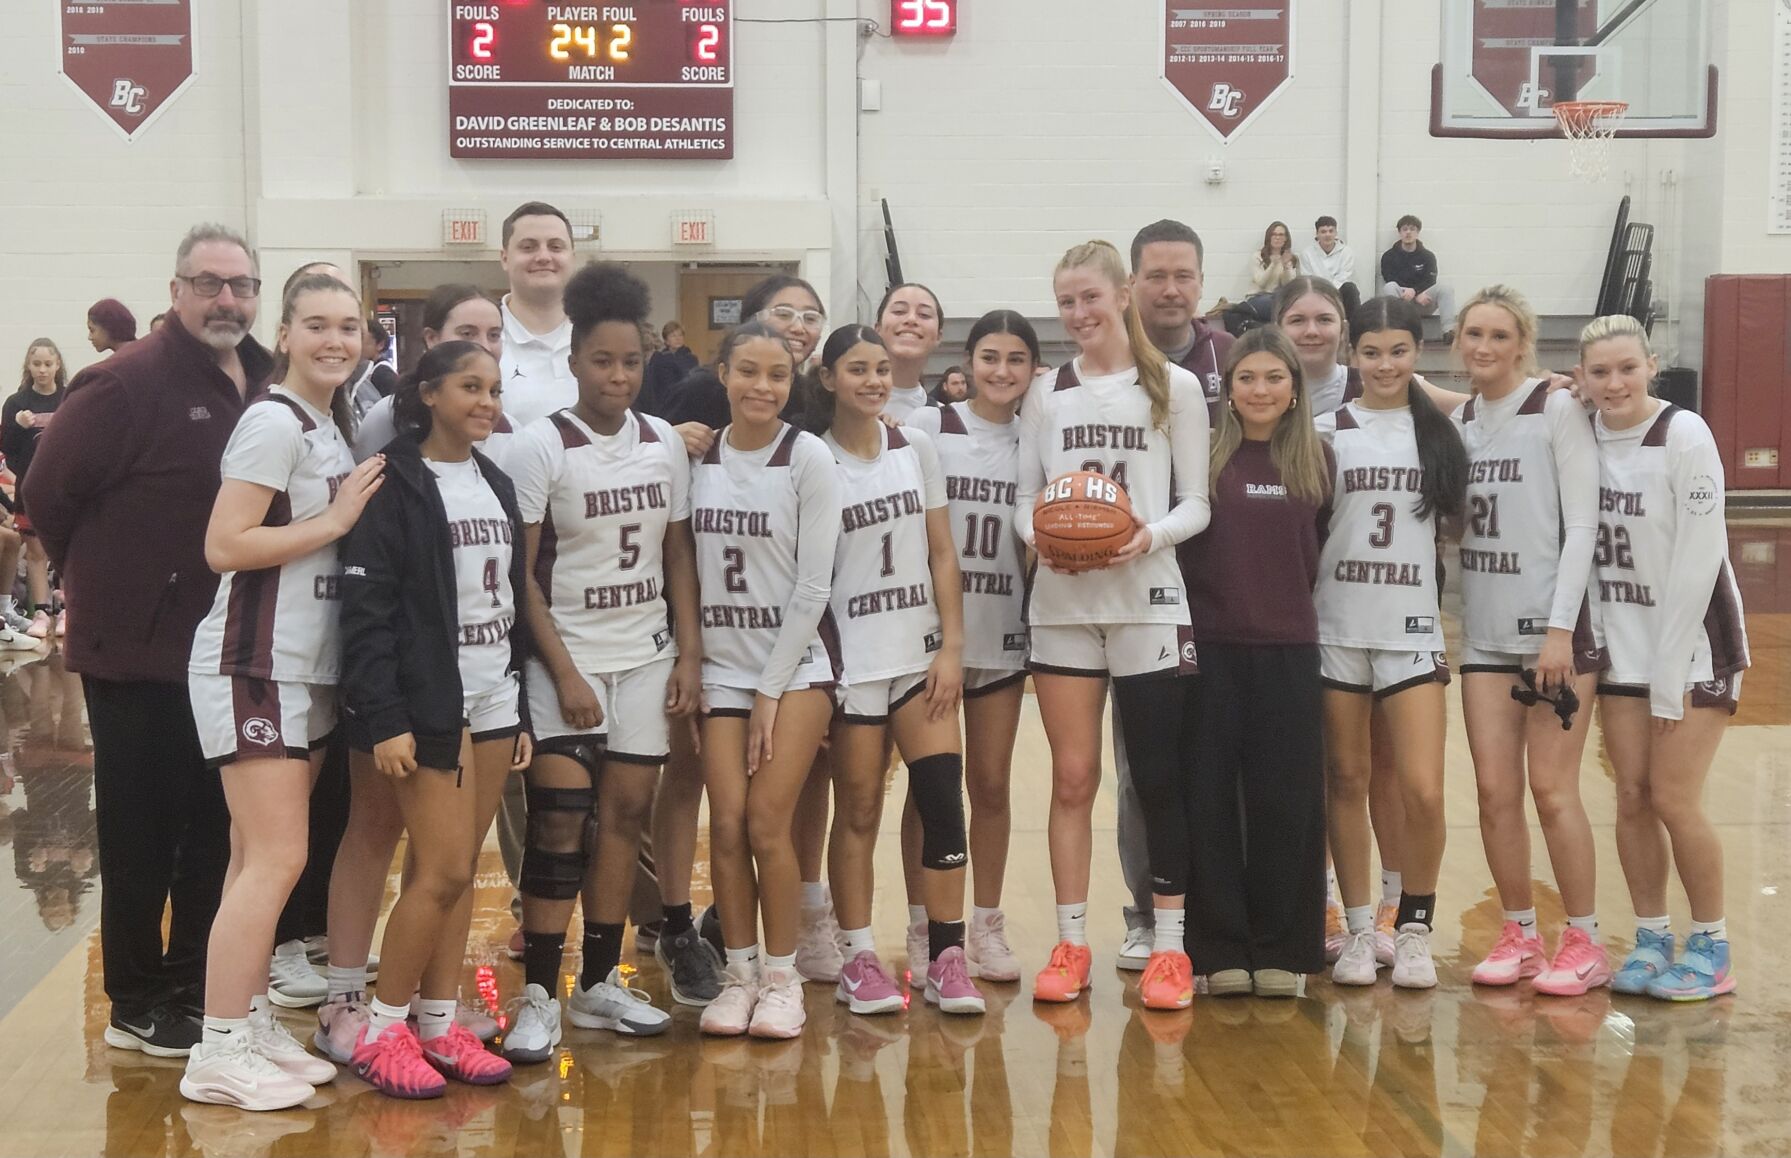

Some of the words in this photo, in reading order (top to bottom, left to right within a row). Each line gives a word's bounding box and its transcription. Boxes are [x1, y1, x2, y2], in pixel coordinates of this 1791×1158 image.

[456, 6, 499, 20] FOULS
[548, 7, 597, 21] PLAYER
[603, 7, 636, 21] FOUL
[682, 8, 724, 22] FOULS
[472, 23, 493, 57] 2
[550, 24, 595, 58] 24
[609, 24, 631, 58] 2
[698, 24, 719, 59] 2
[456, 65, 500, 79] SCORE
[569, 66, 614, 80] MATCH
[682, 67, 725, 80] SCORE
[110, 79, 146, 114] BC
[548, 99, 613, 110] DEDICATED
[615, 100, 634, 110] TO:
[1209, 83, 1243, 117] BC
[456, 117, 504, 131] DAVID
[507, 117, 596, 131] GREENLEAF
[599, 118, 611, 131] &
[614, 118, 647, 131] BOB
[650, 118, 726, 132] DESANTIS
[456, 138, 541, 149] OUTSTANDING
[543, 138, 590, 149] SERVICE
[592, 139, 608, 149] TO
[610, 139, 662, 150] CENTRAL
[664, 139, 725, 150] ATHLETICS
[452, 221, 479, 240] EXIT
[681, 221, 706, 240] EXIT
[1062, 424, 1149, 452] BRISTOL
[584, 482, 667, 519] BRISTOL
[946, 475, 1018, 507] BRISTO
[1045, 477, 1073, 503] BC
[1086, 477, 1117, 503] HS
[1246, 484, 1288, 495] RAMS
[695, 508, 773, 538] BRISTOL
[1368, 502, 1396, 549] 3
[1471, 494, 1500, 539] 21
[449, 518, 513, 548] BRISTO
[618, 522, 642, 571] 5
[962, 511, 1003, 560] 10
[880, 530, 895, 577] 1
[483, 557, 500, 608] 4
[722, 546, 749, 593] 2
[961, 570, 1013, 596] NTRAL
[1334, 560, 1422, 587] CENTRAL
[848, 583, 928, 619] CENTRAL
[702, 605, 783, 629] CENTRAL
